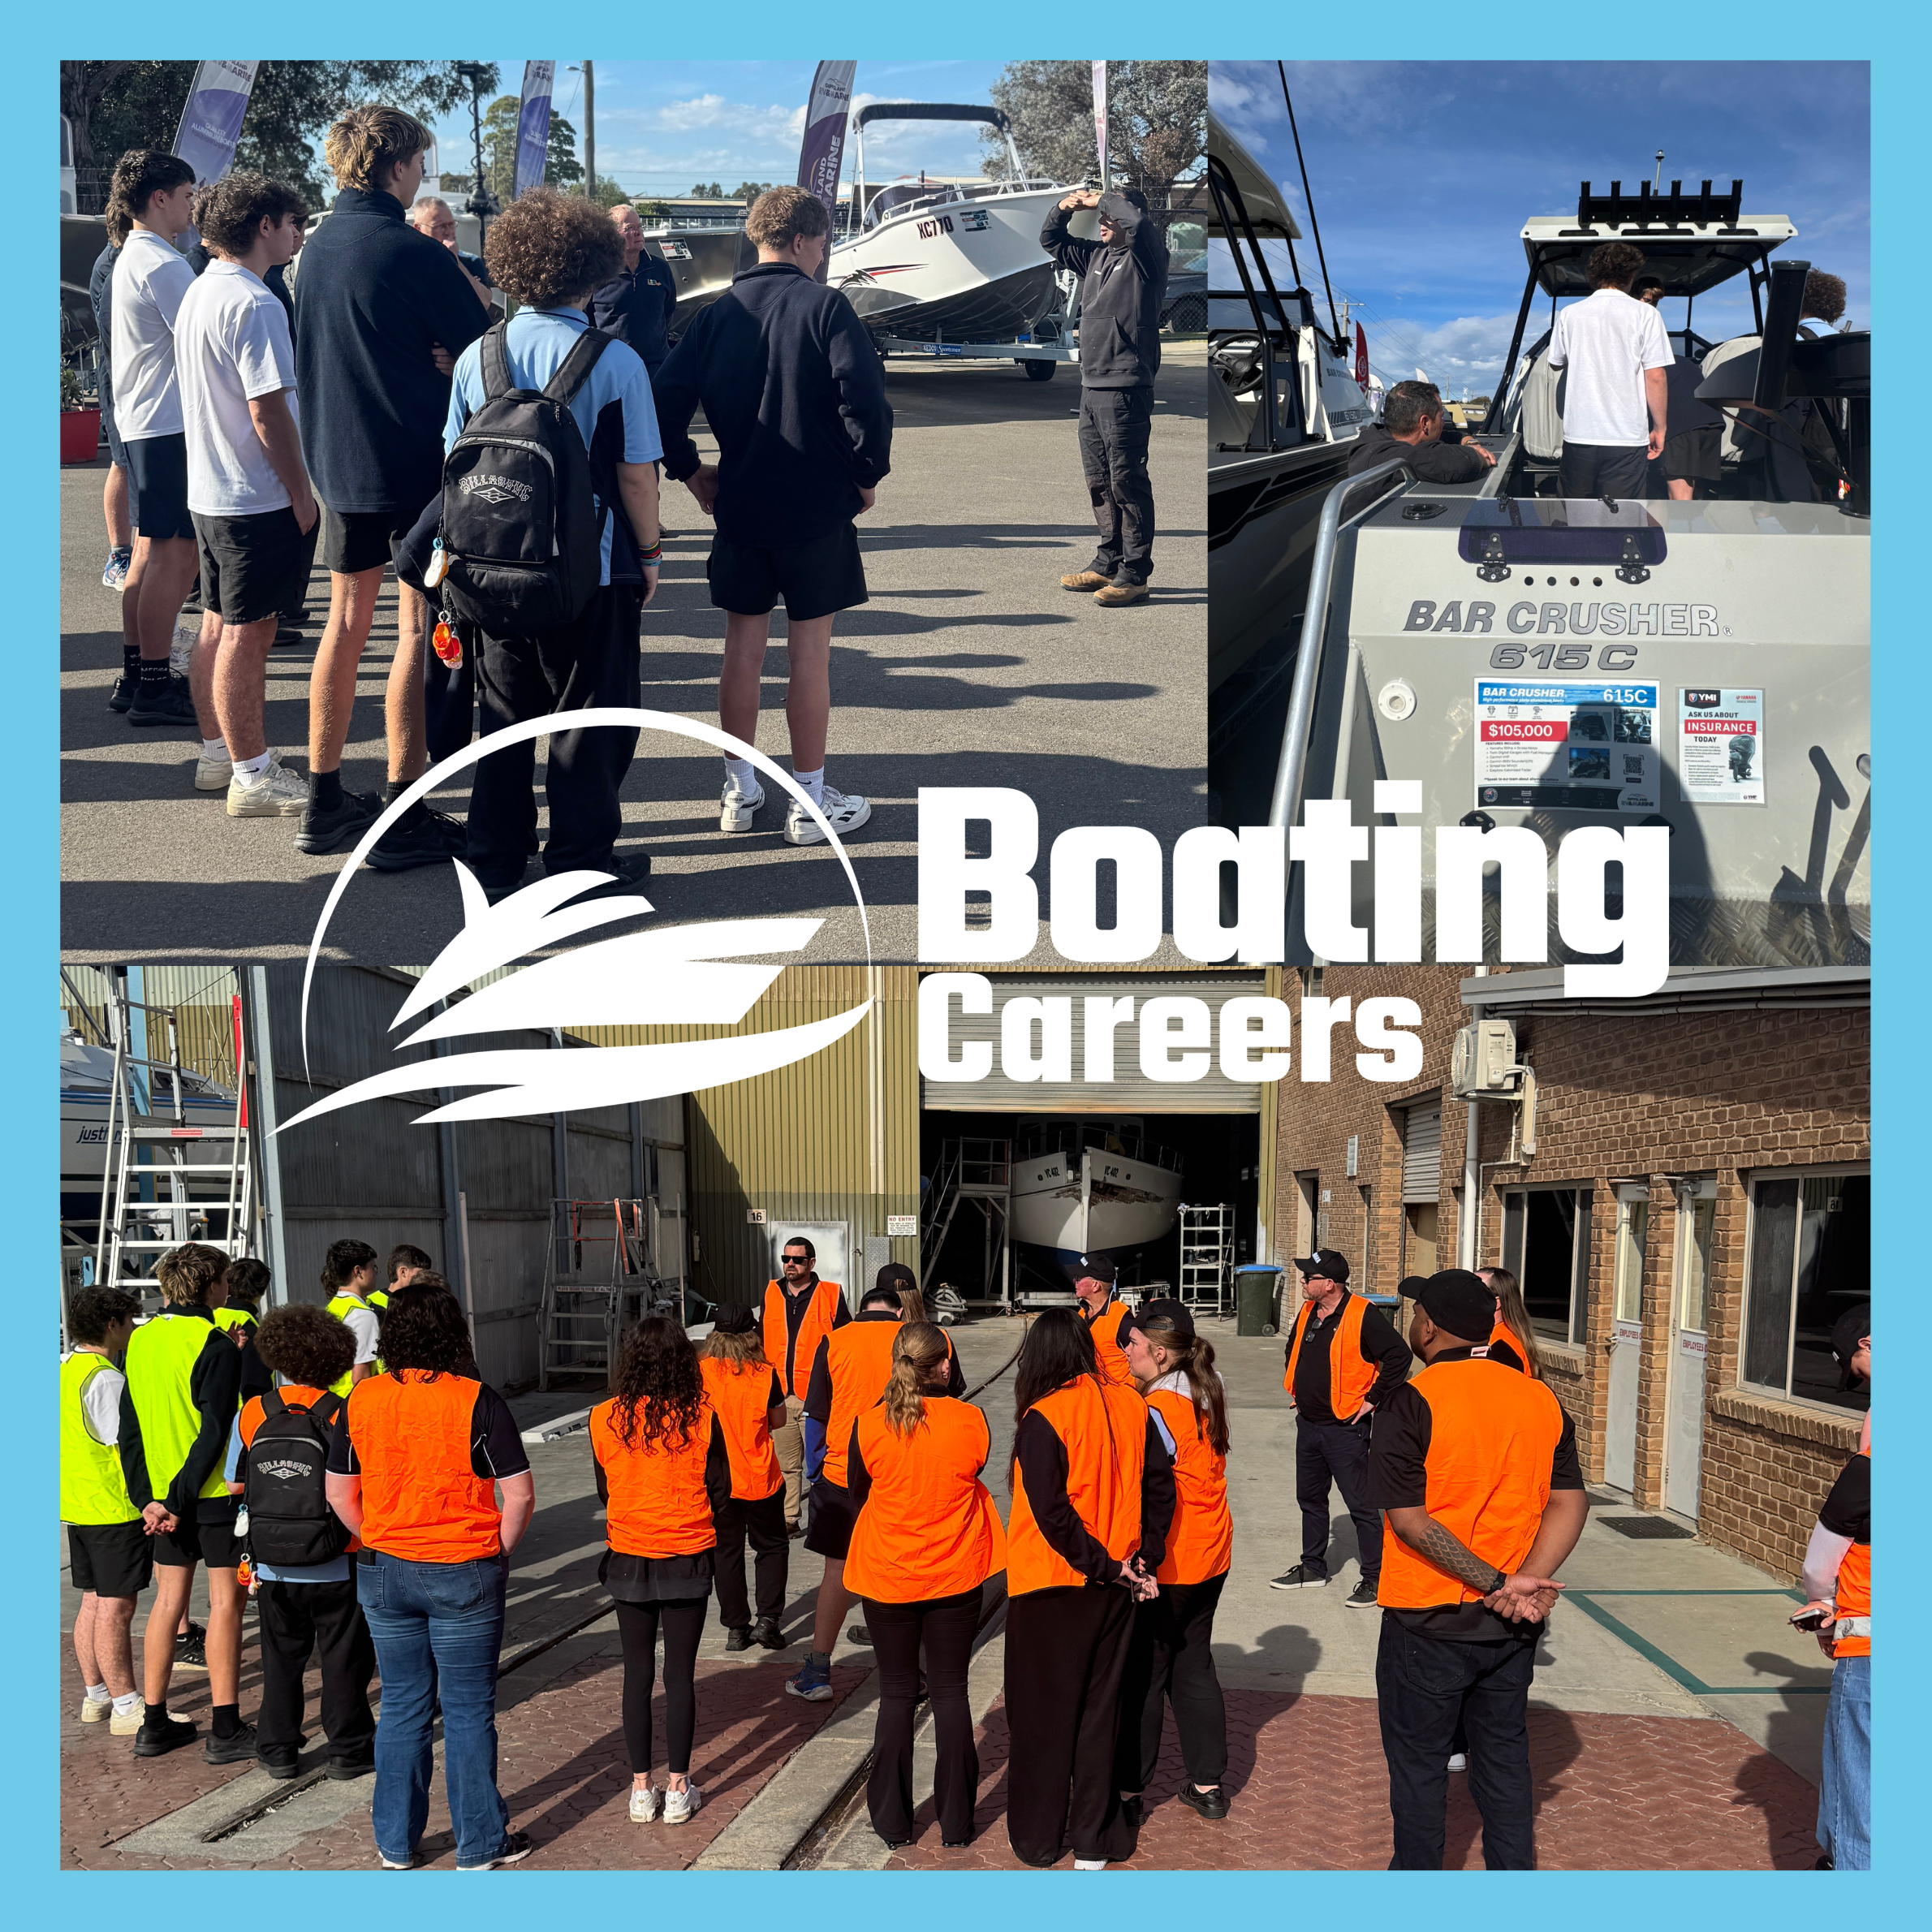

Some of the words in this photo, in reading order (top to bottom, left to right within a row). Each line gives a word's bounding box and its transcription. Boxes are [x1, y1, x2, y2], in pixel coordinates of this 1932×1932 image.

[459, 474, 533, 502] BILLABONG
[1403, 600, 1496, 633] BAR
[1507, 602, 1719, 636] CRUSHER
[1482, 687, 1507, 696] BAR
[1509, 688, 1565, 697] CRUSHER
[1603, 688, 1648, 704] 615C
[1488, 723, 1553, 739] $105,000
[1688, 722, 1753, 733] INSURANCE
[751, 1212, 762, 1221] 16
[1619, 1328, 1638, 1339] EMPLOYEES
[1683, 1339, 1704, 1352] EMPLOYEES
